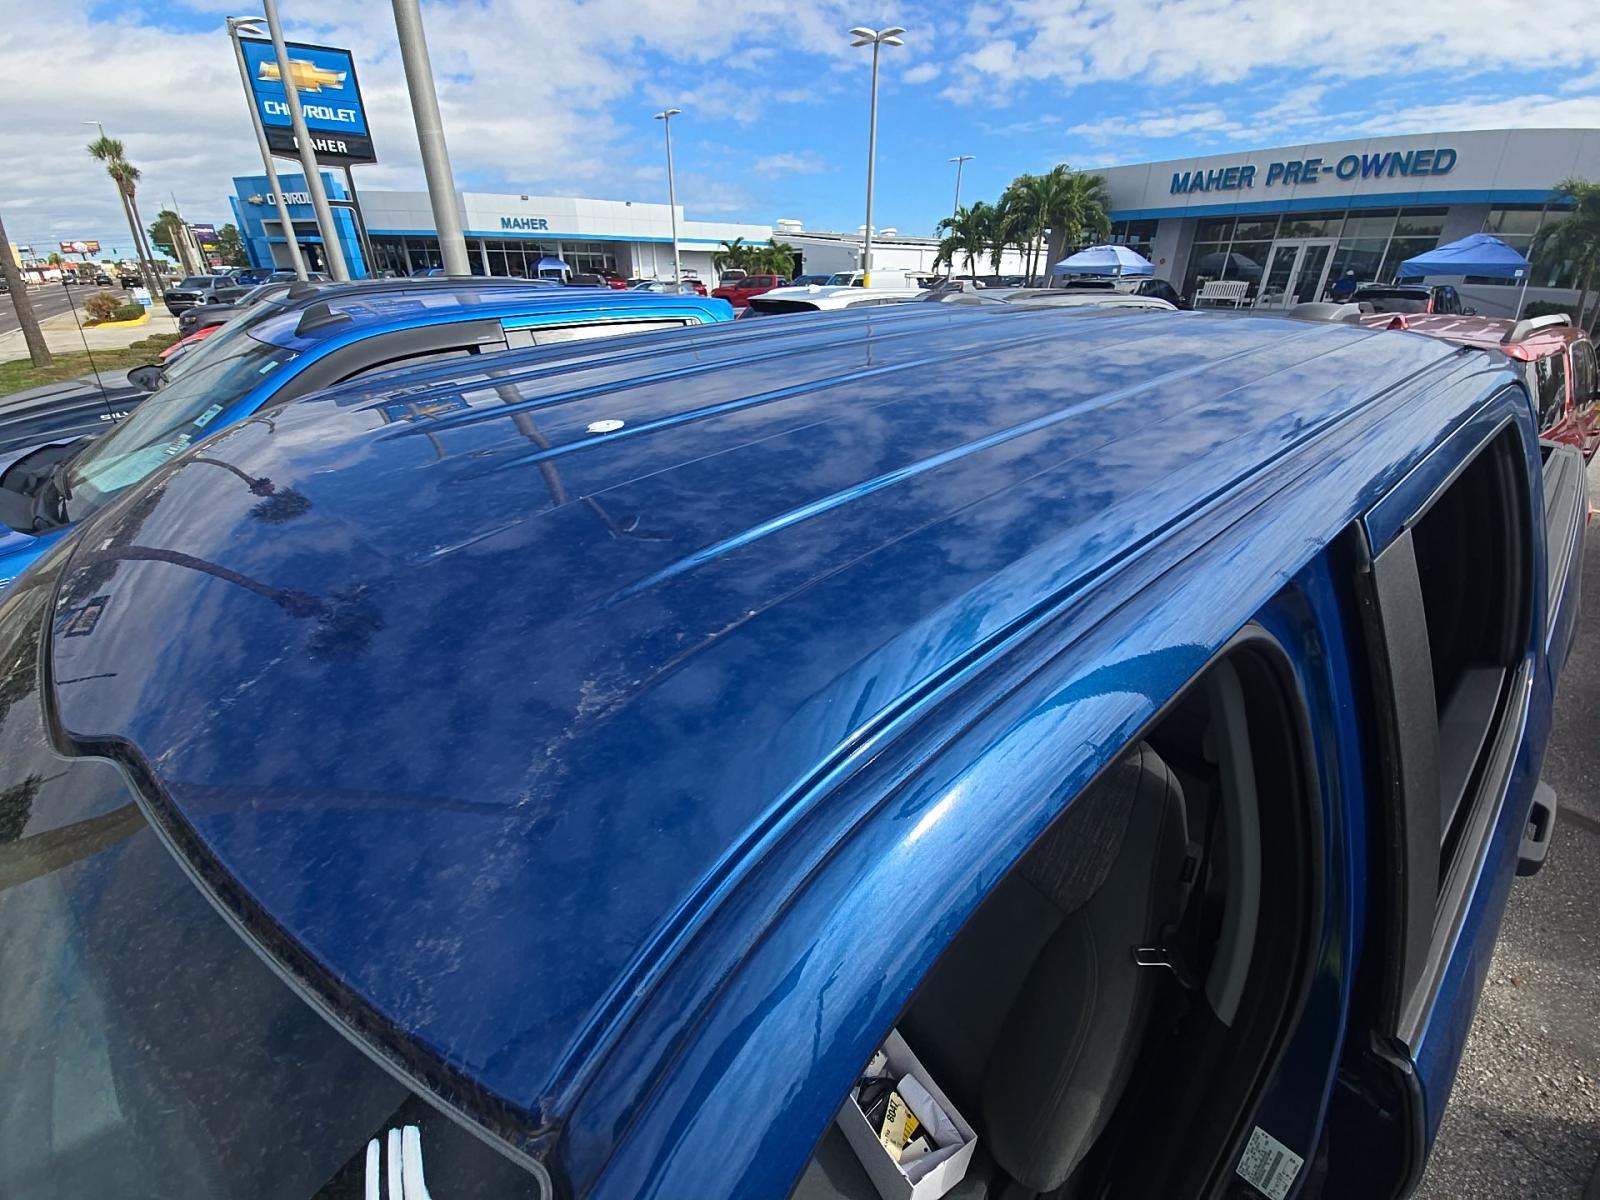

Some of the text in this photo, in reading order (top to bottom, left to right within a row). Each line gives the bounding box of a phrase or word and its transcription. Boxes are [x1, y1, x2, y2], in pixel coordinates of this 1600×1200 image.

[263, 101, 356, 122] CHVROLET
[1169, 148, 1458, 194] MAHER PRE-OWNED
[500, 217, 549, 230] MAHER
